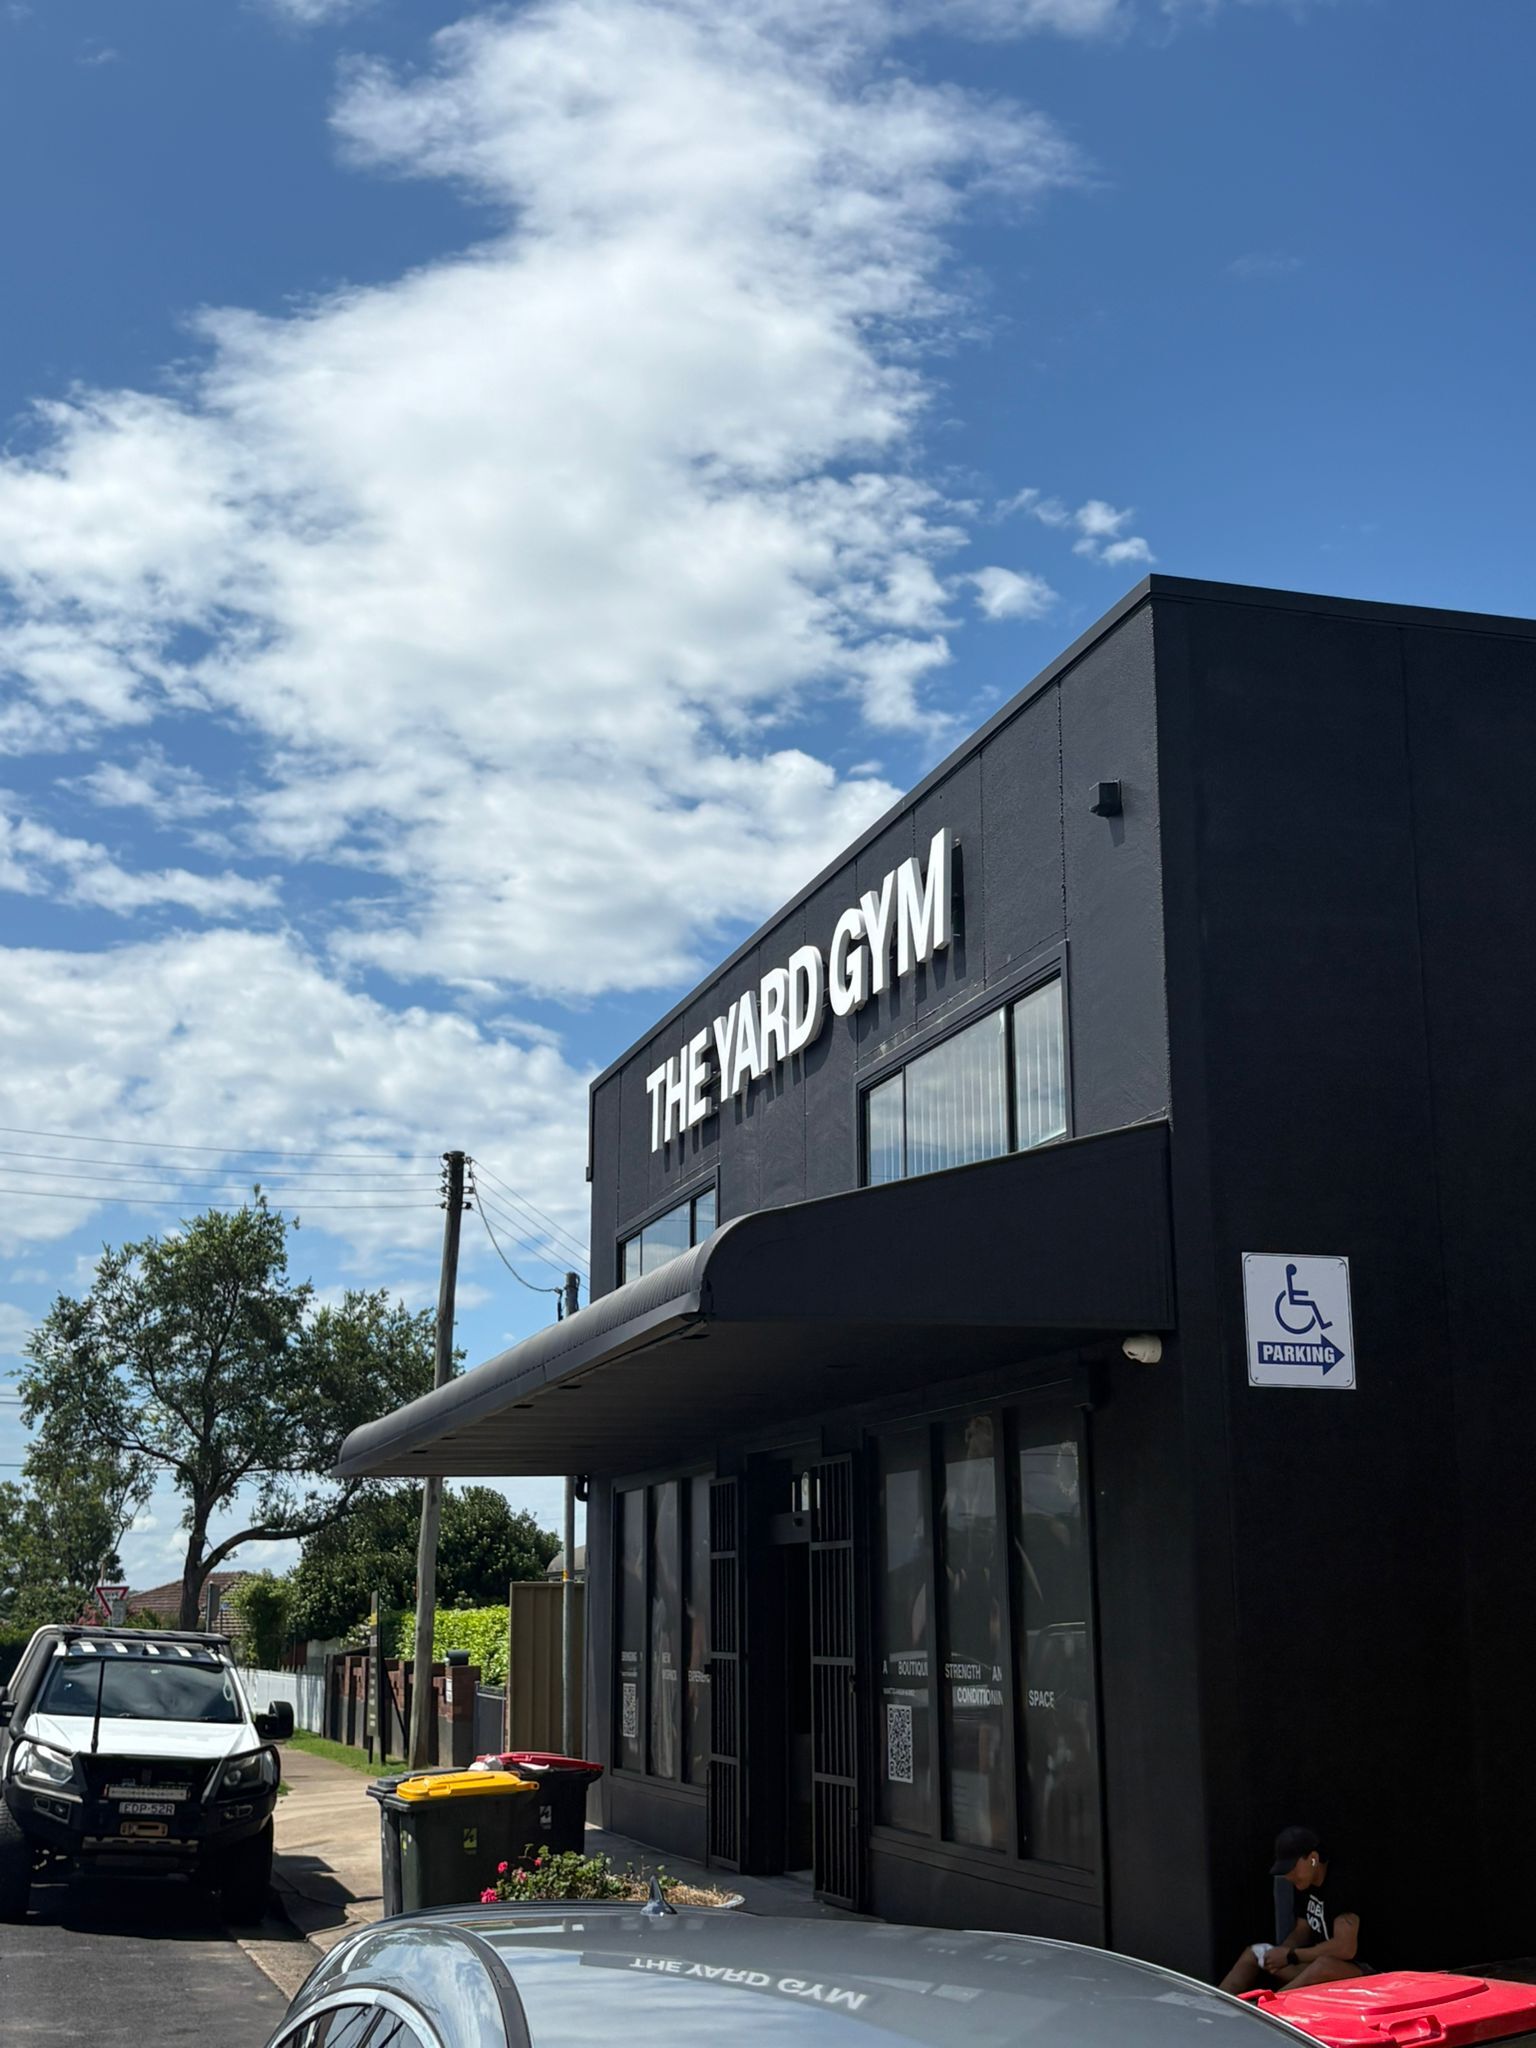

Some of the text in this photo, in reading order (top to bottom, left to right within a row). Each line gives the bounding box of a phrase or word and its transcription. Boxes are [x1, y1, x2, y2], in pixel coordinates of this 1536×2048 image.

[646, 827, 952, 1153] THE YARD GYM
[1262, 1344, 1336, 1364] PARKING
[898, 1661, 929, 1677] BOUTIQU
[944, 1663, 982, 1680] STRENGTH
[1028, 1689, 1055, 1708] SPACE
